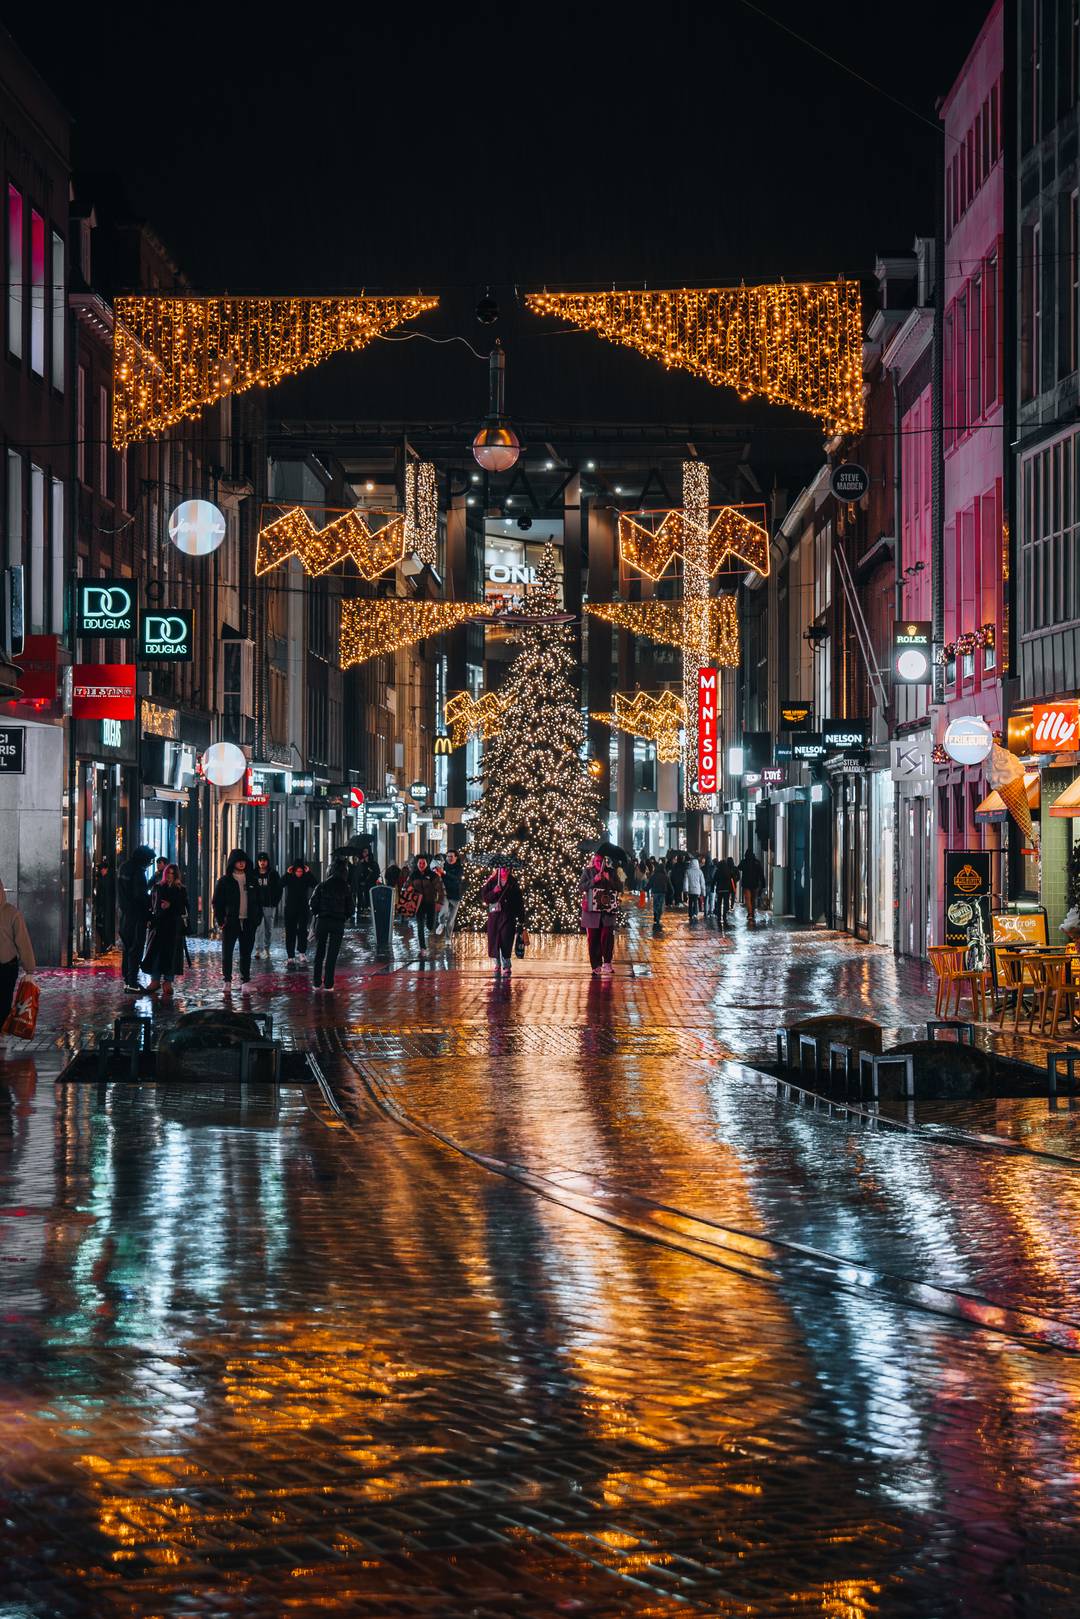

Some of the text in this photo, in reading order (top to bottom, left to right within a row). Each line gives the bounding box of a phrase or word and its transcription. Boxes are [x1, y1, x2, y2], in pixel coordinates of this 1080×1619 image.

[840, 473, 859, 482] STEVE
[489, 565, 543, 584] ONL
[83, 619, 131, 629] DOUGLAS
[896, 635, 928, 644] ROLEX
[145, 645, 187, 654] DOUGLAS
[699, 675, 715, 770] MINISO
[825, 734, 863, 743] NELSON
